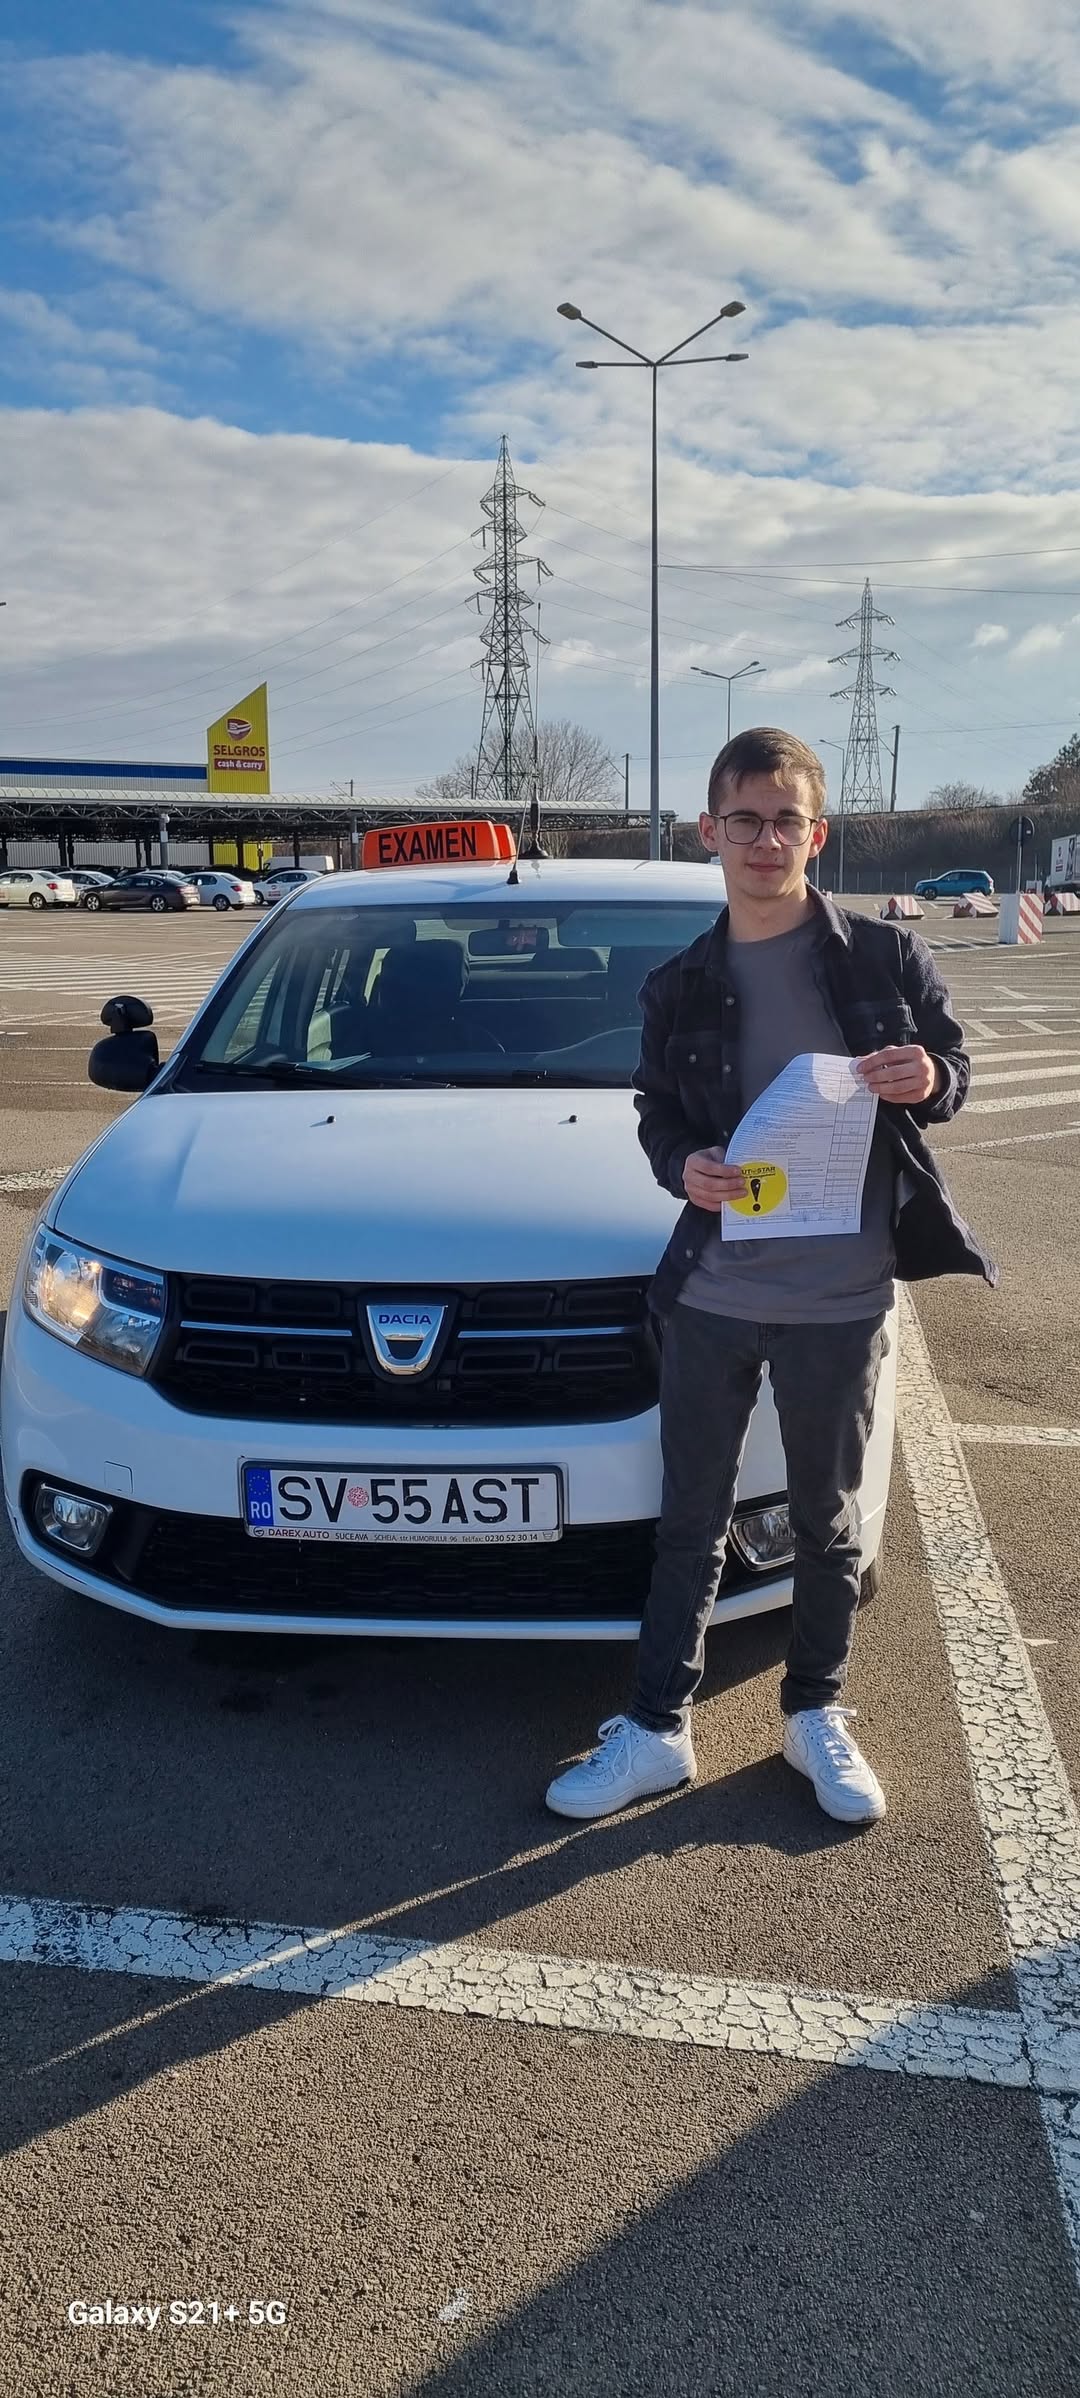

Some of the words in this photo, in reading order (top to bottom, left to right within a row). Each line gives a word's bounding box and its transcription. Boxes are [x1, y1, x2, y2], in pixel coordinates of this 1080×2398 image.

[213, 744, 266, 757] SELGROS
[217, 760, 235, 768] cash
[243, 761, 263, 770] carry
[378, 825, 477, 864] EXAMEN
[378, 1314, 432, 1325] DACIA
[278, 1476, 348, 1523] SV
[370, 1478, 432, 1525] 55
[441, 1477, 540, 1524] AST
[250, 1501, 272, 1519] RO
[268, 1528, 301, 1538] DAREX
[302, 1530, 330, 1539] AUTO
[335, 1532, 369, 1541] SUCEAVA
[485, 1534, 505, 1542] 0230
[529, 1533, 538, 1541] 14
